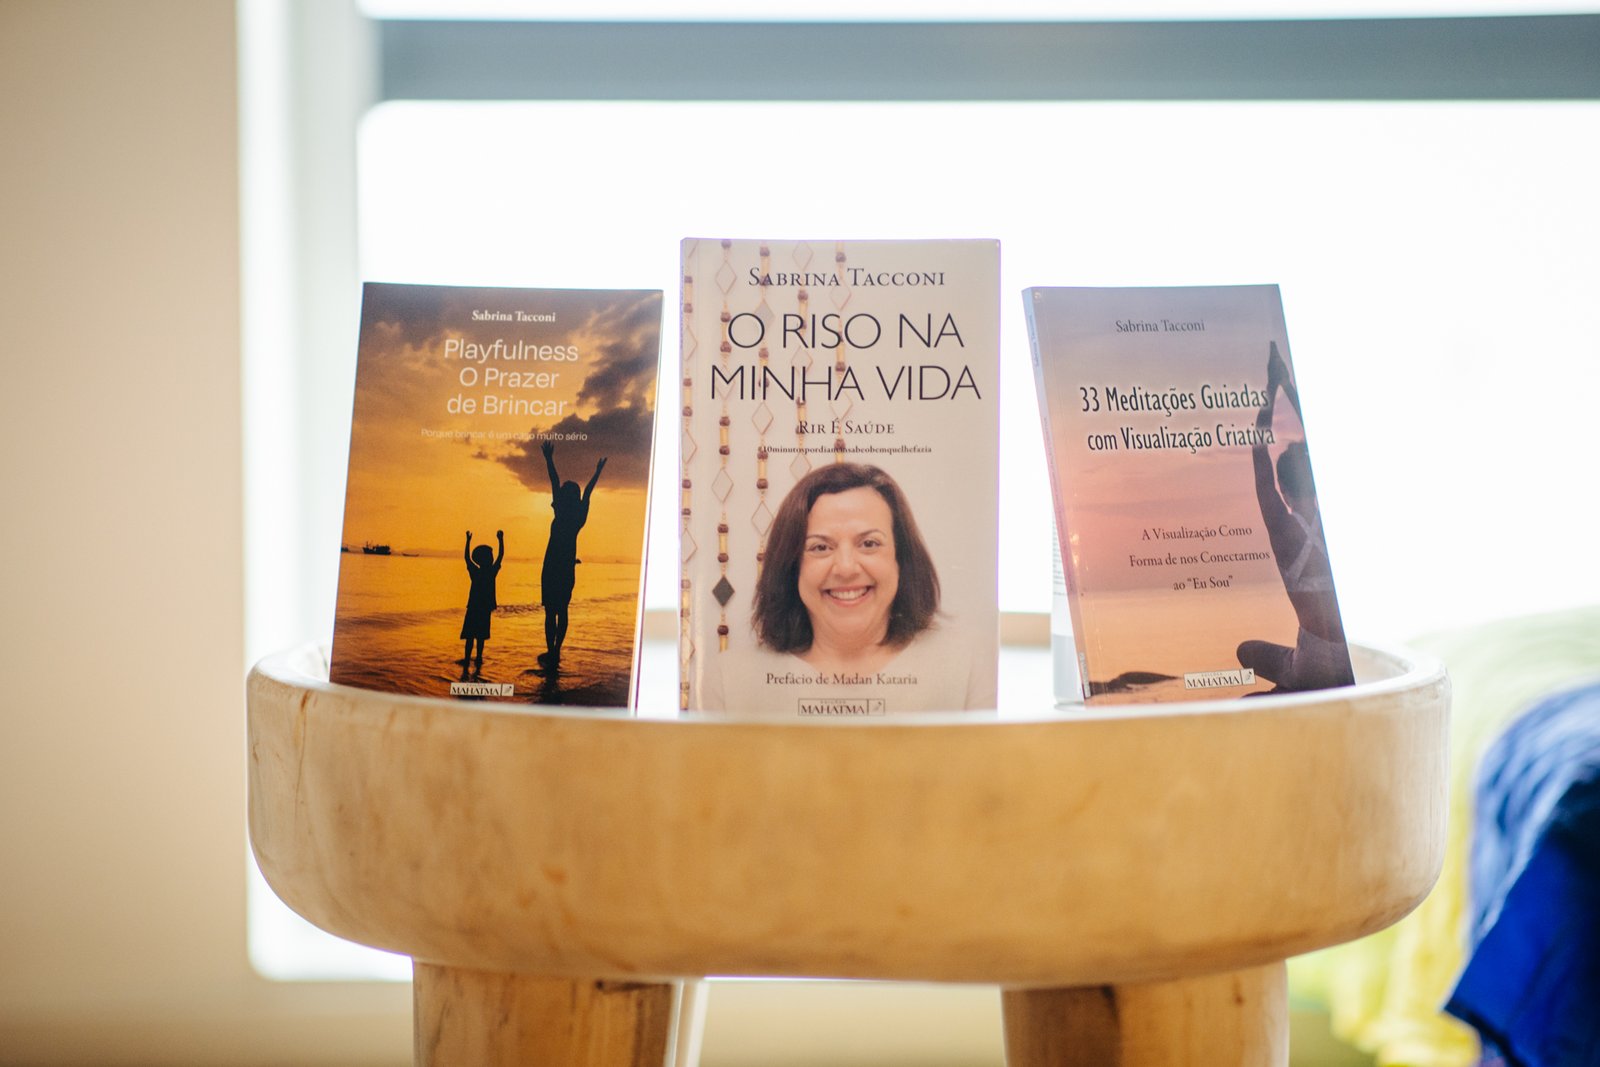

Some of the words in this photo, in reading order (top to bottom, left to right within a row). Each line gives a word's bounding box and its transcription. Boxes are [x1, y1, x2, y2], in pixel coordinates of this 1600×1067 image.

[749, 267, 840, 287] SABRINA
[847, 268, 946, 287] TACCONI
[472, 310, 512, 321] Sabrina
[515, 311, 556, 322] Tacconi
[728, 312, 765, 349] O
[783, 313, 882, 349] RISO
[899, 313, 965, 349] NA
[1116, 319, 1158, 333] Sabrina
[1161, 319, 1205, 332] Tacconi
[444, 339, 578, 364] Playfulness
[459, 367, 478, 387] O
[484, 368, 560, 388] Prazer
[711, 365, 865, 401] MINHA
[876, 365, 982, 400] VIDA
[447, 394, 476, 414] de
[483, 395, 567, 416] Brincar
[1079, 386, 1100, 412] 33
[1105, 386, 1196, 417] Meditações
[1201, 384, 1269, 410] Guiadas
[421, 428, 453, 439] Porque
[455, 429, 485, 439] brincar
[488, 430, 494, 439] é
[496, 432, 512, 440] um
[536, 431, 564, 441] muito
[565, 432, 588, 441] sério
[799, 420, 826, 434] RIR
[831, 417, 842, 434] É
[845, 419, 895, 435] SAÚDE
[1087, 432, 1117, 450] com
[1120, 425, 1212, 455] Visualização
[1216, 423, 1276, 447] Criativa
[1142, 529, 1150, 541] A
[1152, 526, 1216, 544] Visualização
[1219, 525, 1253, 537] Como
[1129, 554, 1162, 567] Forma
[1165, 553, 1178, 565] de
[1180, 554, 1198, 565] nos
[1200, 550, 1270, 563] Conectarmos
[1173, 582, 1185, 591] ao
[766, 672, 812, 685] Prefácio
[816, 672, 829, 685] de
[832, 673, 872, 685] Madan
[876, 673, 918, 685] Kataria
[1186, 676, 1240, 688] MAHATMA
[451, 687, 499, 695] MAHATMA
[801, 704, 865, 714] MAHATMA
